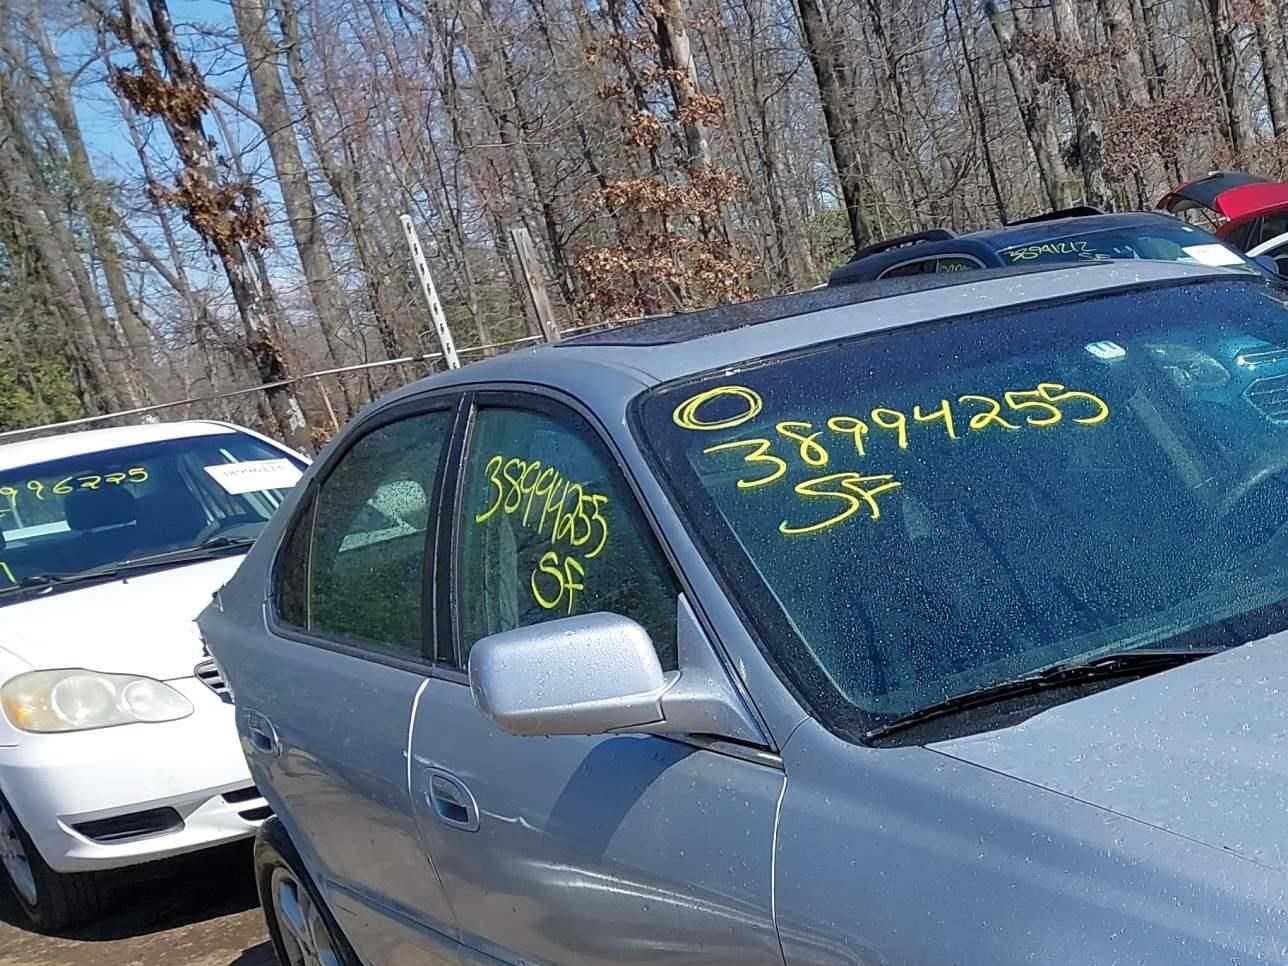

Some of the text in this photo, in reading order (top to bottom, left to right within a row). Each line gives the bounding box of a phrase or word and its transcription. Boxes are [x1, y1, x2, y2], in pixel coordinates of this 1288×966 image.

[703, 383, 1110, 489] 38994255
[475, 455, 609, 558] 38994255
[779, 472, 902, 534] SF
